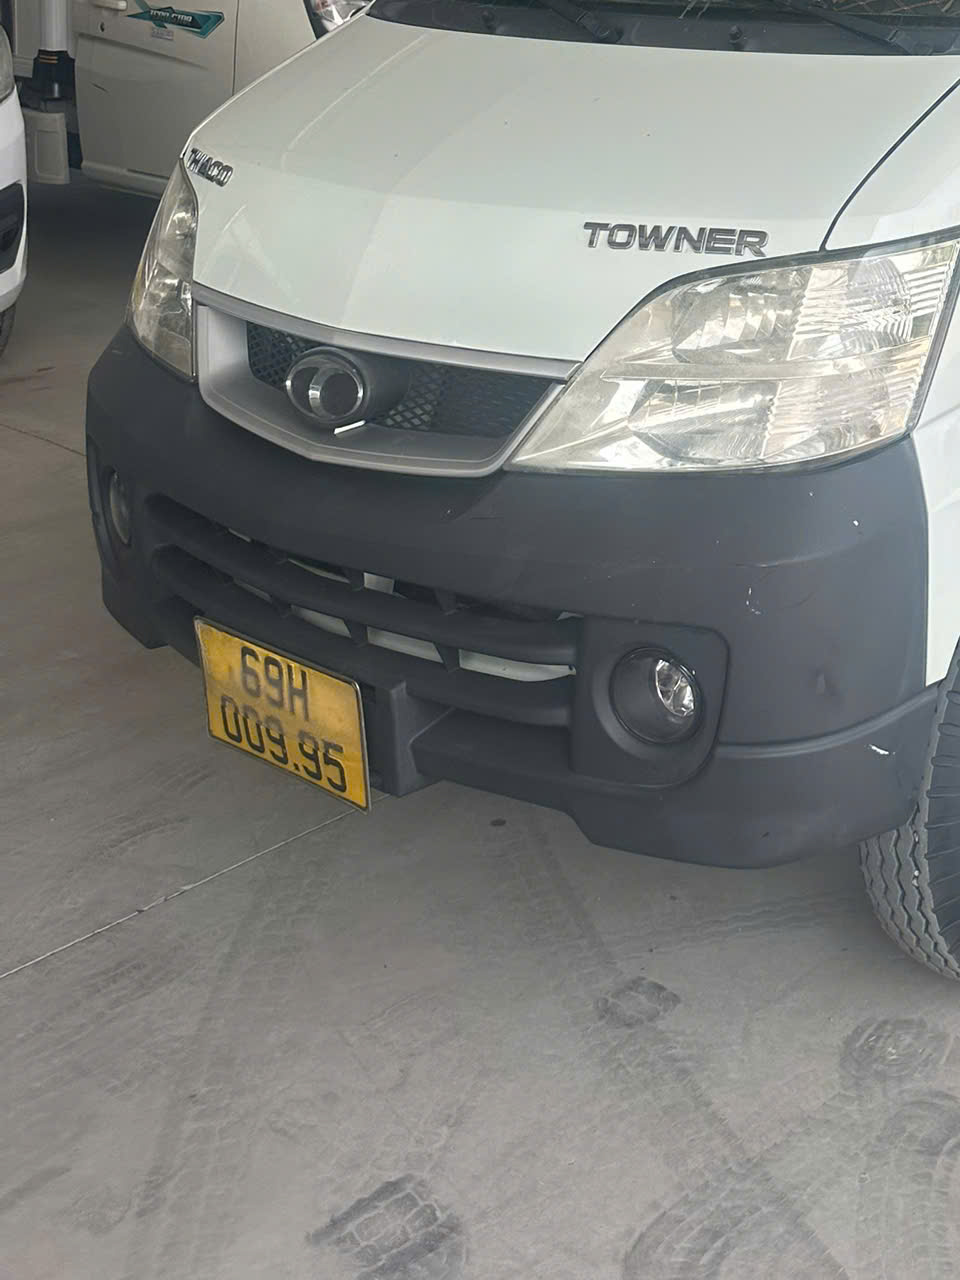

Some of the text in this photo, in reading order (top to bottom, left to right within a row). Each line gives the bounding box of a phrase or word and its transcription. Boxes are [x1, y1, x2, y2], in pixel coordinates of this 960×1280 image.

[584, 221, 769, 257] TOWNER
[241, 646, 309, 720] 69H
[221, 694, 347, 793] 009.95
